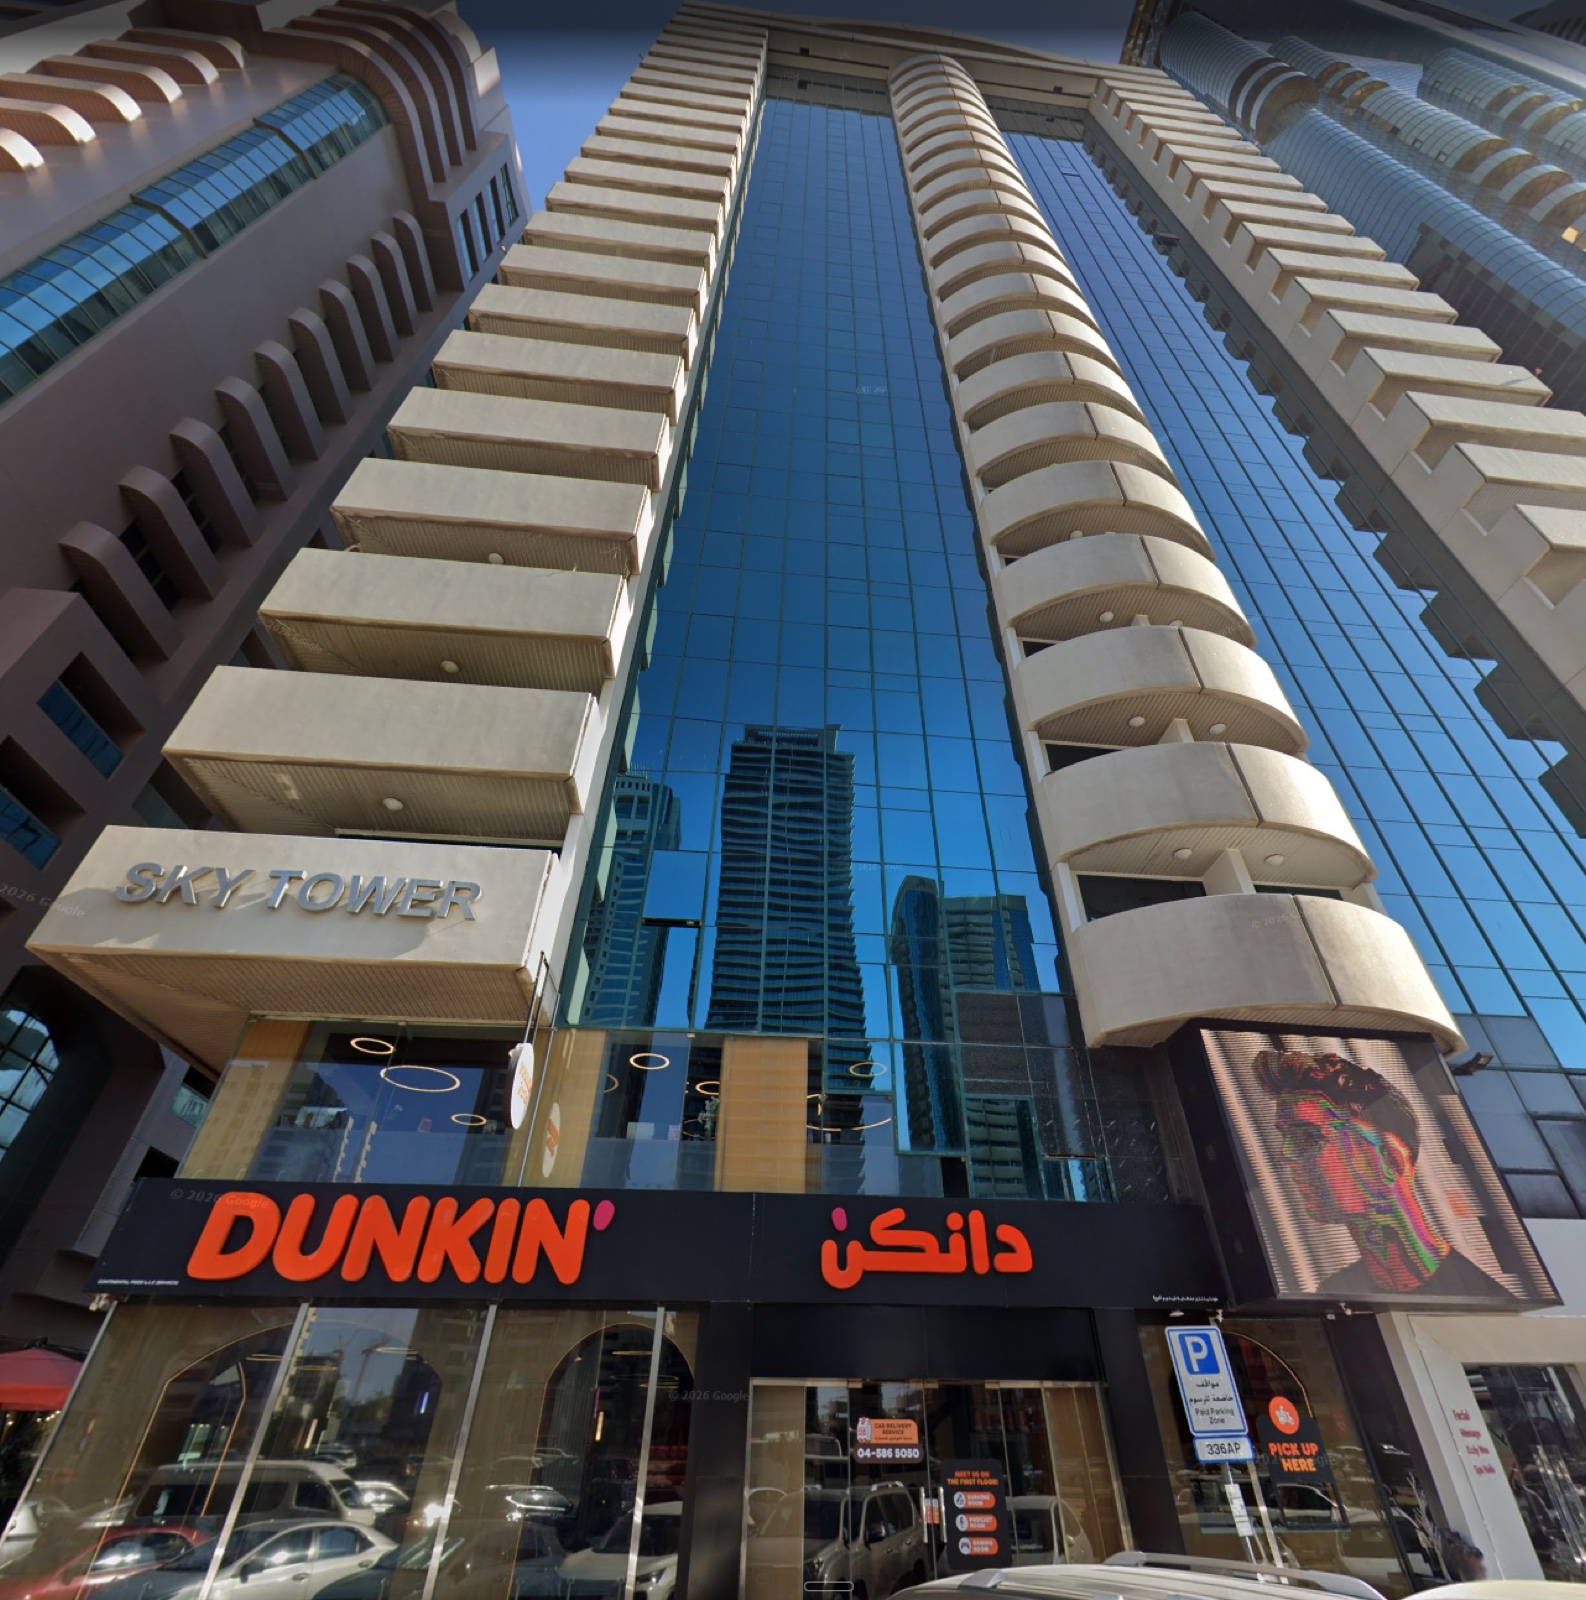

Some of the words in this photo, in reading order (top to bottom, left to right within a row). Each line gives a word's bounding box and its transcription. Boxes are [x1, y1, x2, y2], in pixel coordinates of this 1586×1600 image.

[115, 862, 255, 908] SKY
[267, 869, 482, 921] TOWER
[187, 1191, 615, 1285] DUNKIN'
[821, 1207, 1034, 1289] دانكن
[1184, 1336, 1208, 1372] P
[1195, 1379, 1219, 1388] مواقف
[1195, 1408, 1210, 1416] Paid
[1210, 1407, 1235, 1417] Parking
[1209, 1416, 1225, 1424] Zone
[895, 1448, 920, 1458] 5050
[1206, 1443, 1241, 1455] 336AP
[1268, 1442, 1300, 1456] PICK
[1300, 1442, 1319, 1456] UP
[1281, 1458, 1317, 1472] HERE
